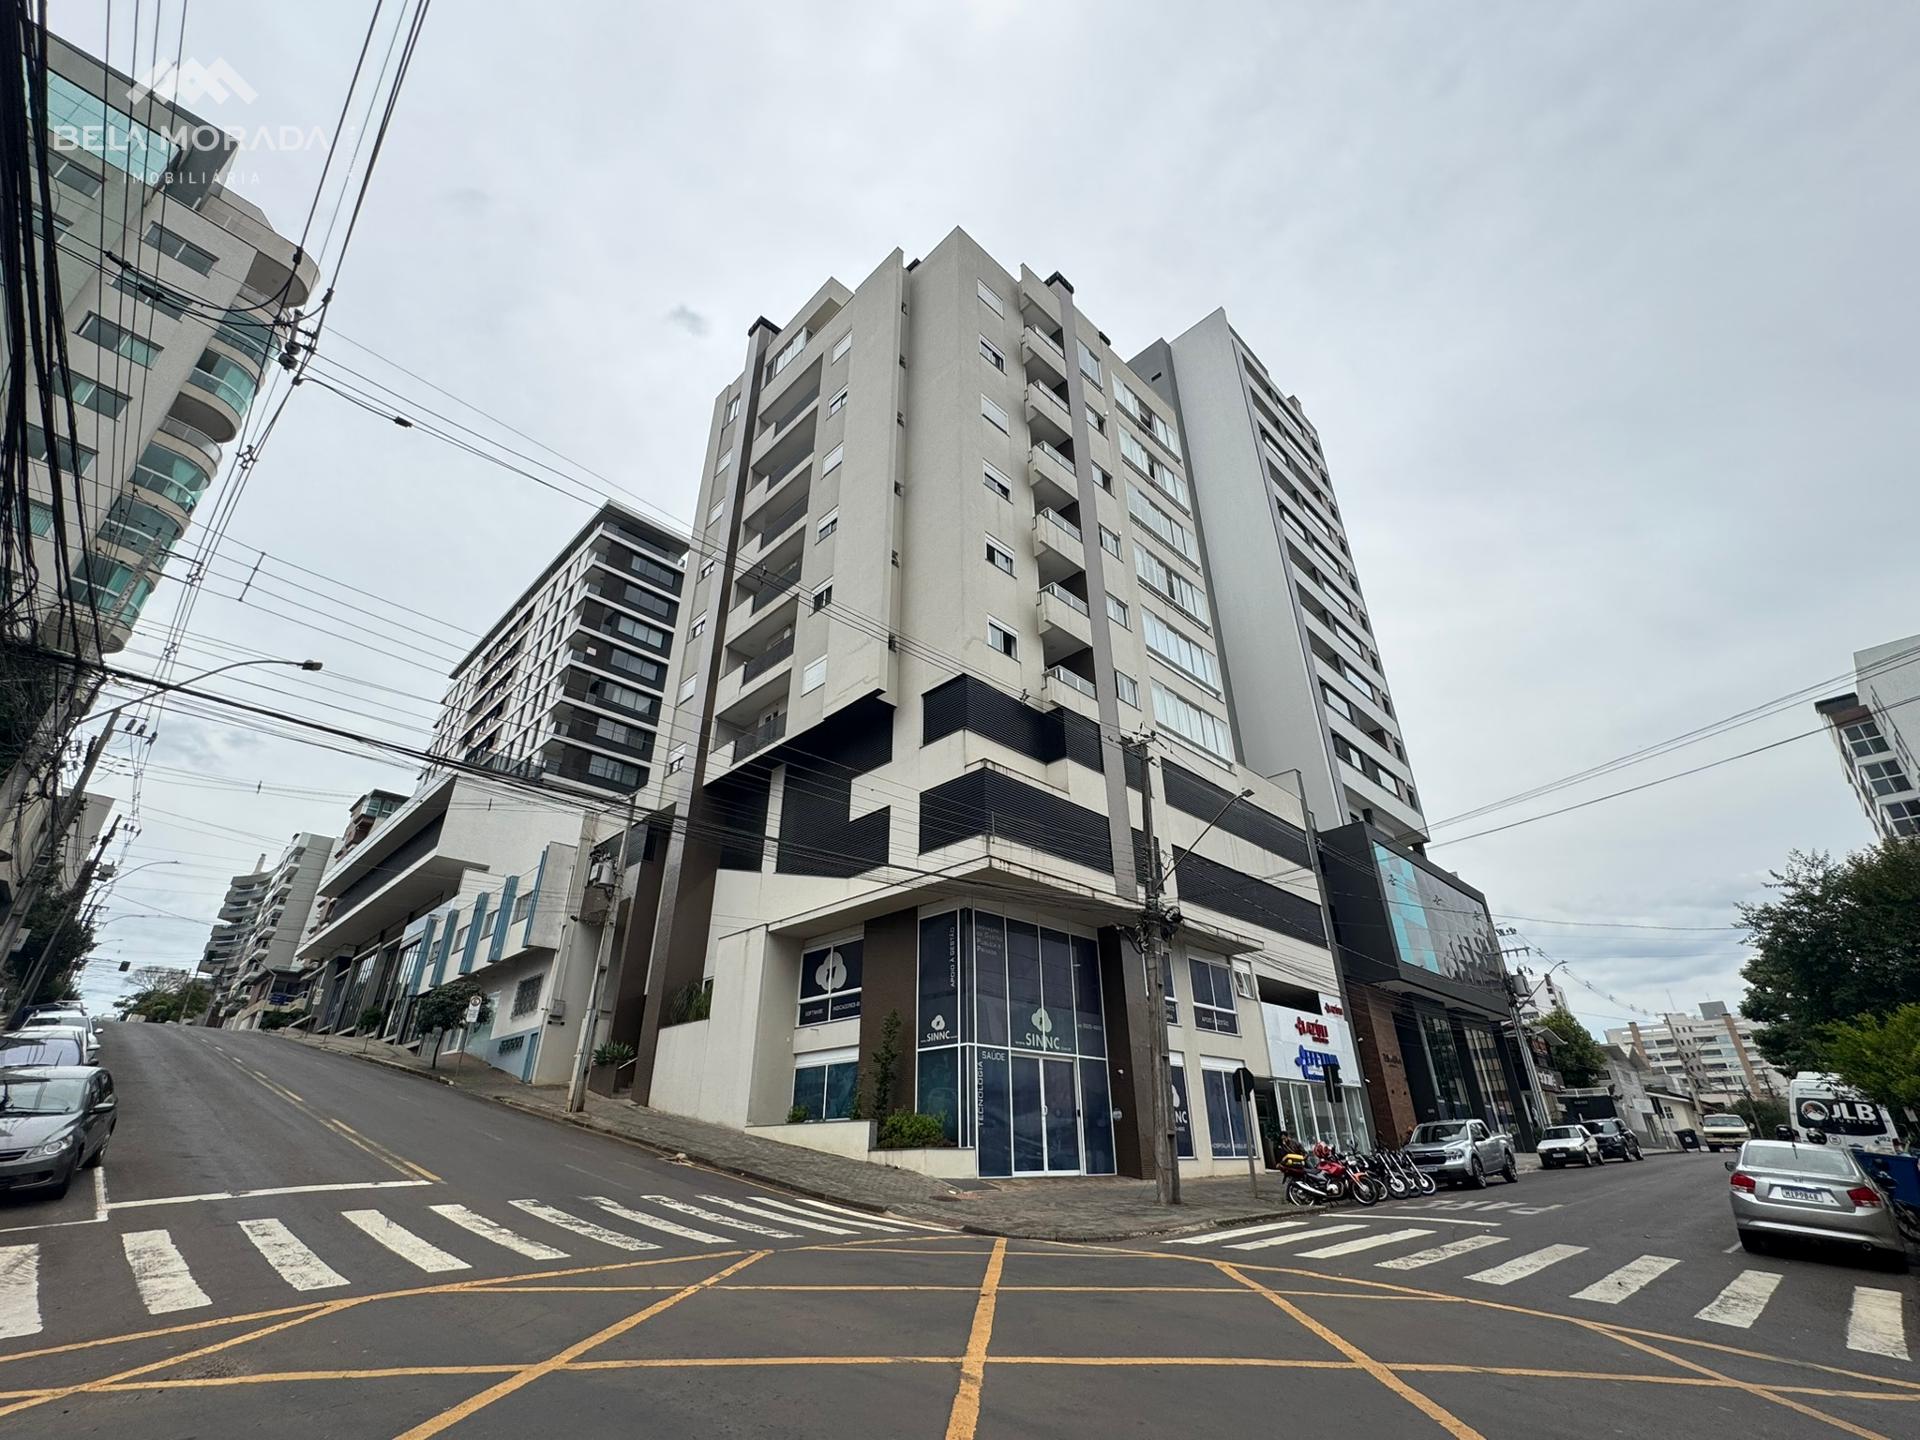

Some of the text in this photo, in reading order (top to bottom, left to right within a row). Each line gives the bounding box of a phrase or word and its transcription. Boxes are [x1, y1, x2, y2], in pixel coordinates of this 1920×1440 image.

[926, 1030, 950, 1042] SINNC
[1025, 1032, 1060, 1050] SINNC
[981, 1049, 1007, 1062] SAÚDE
[977, 1060, 985, 1128] TECNOLOGIA
[1831, 1102, 1877, 1121] JLB
